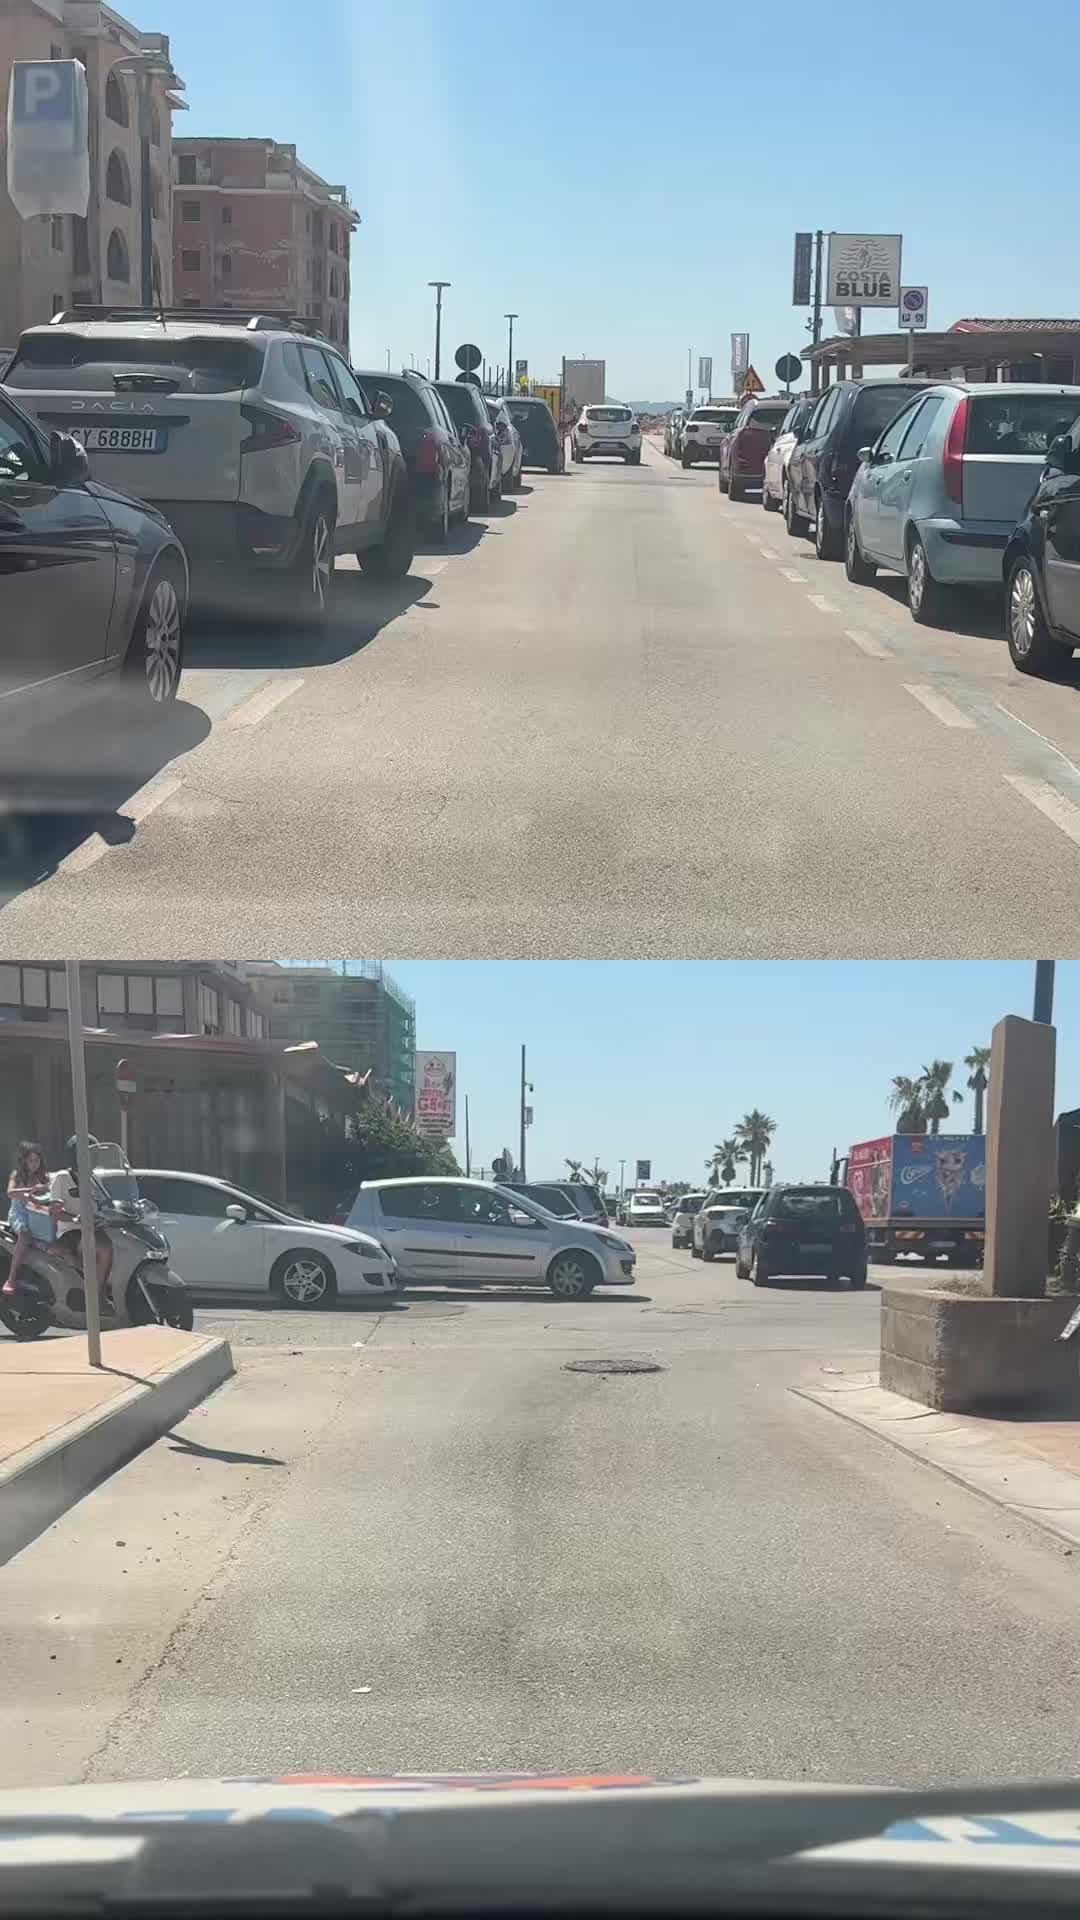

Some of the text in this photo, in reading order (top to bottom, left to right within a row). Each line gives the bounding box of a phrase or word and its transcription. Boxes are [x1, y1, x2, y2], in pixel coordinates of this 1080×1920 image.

[25, 69, 61, 112] P
[836, 271, 891, 282] COSTA
[836, 282, 891, 297] BLUE
[71, 400, 154, 411] DACIA
[98, 431, 153, 447] 688BH
